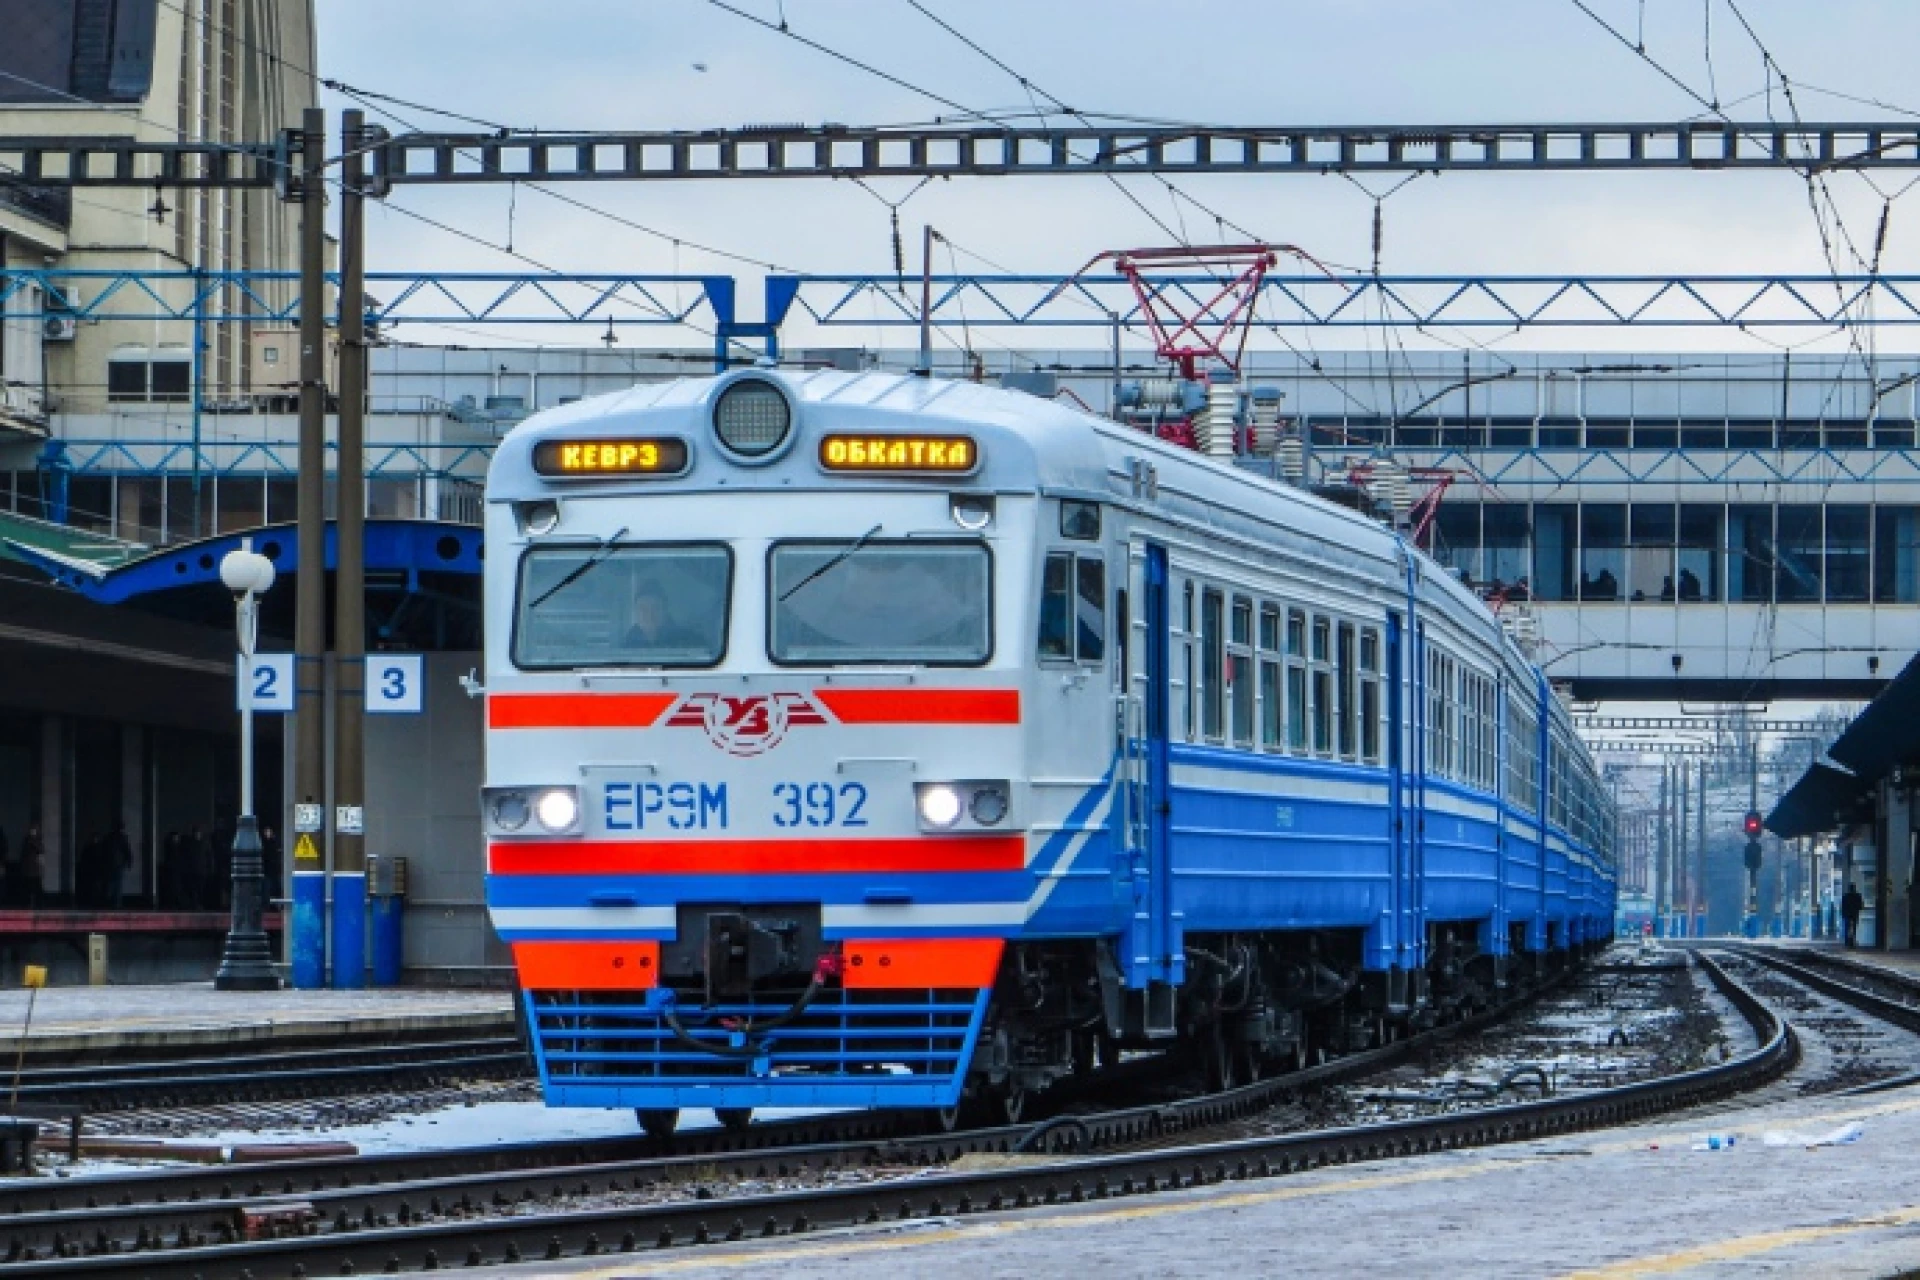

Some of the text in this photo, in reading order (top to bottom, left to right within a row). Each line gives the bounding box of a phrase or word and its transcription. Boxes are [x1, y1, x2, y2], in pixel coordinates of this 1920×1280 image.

[561, 444, 658, 468] КЕВРЗ
[827, 440, 967, 464] ОБКАТКА
[253, 665, 278, 698] 2
[381, 667, 406, 699] 3
[773, 782, 869, 828] 392
